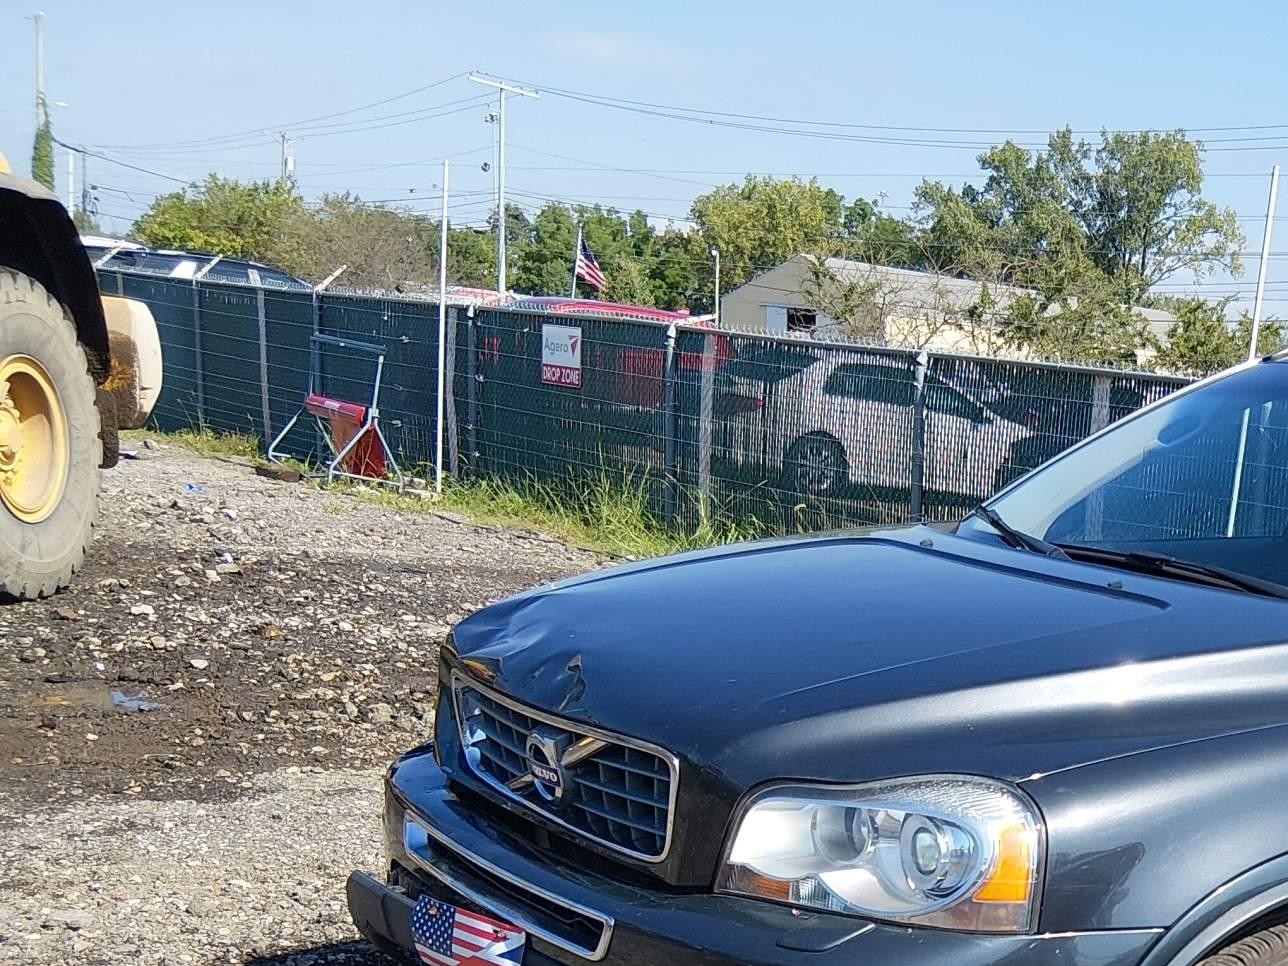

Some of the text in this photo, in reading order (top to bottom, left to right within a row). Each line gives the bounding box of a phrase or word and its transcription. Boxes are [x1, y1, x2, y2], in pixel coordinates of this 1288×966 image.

[544, 336, 569, 355] Agero
[543, 366, 579, 385] DROP ZONE
